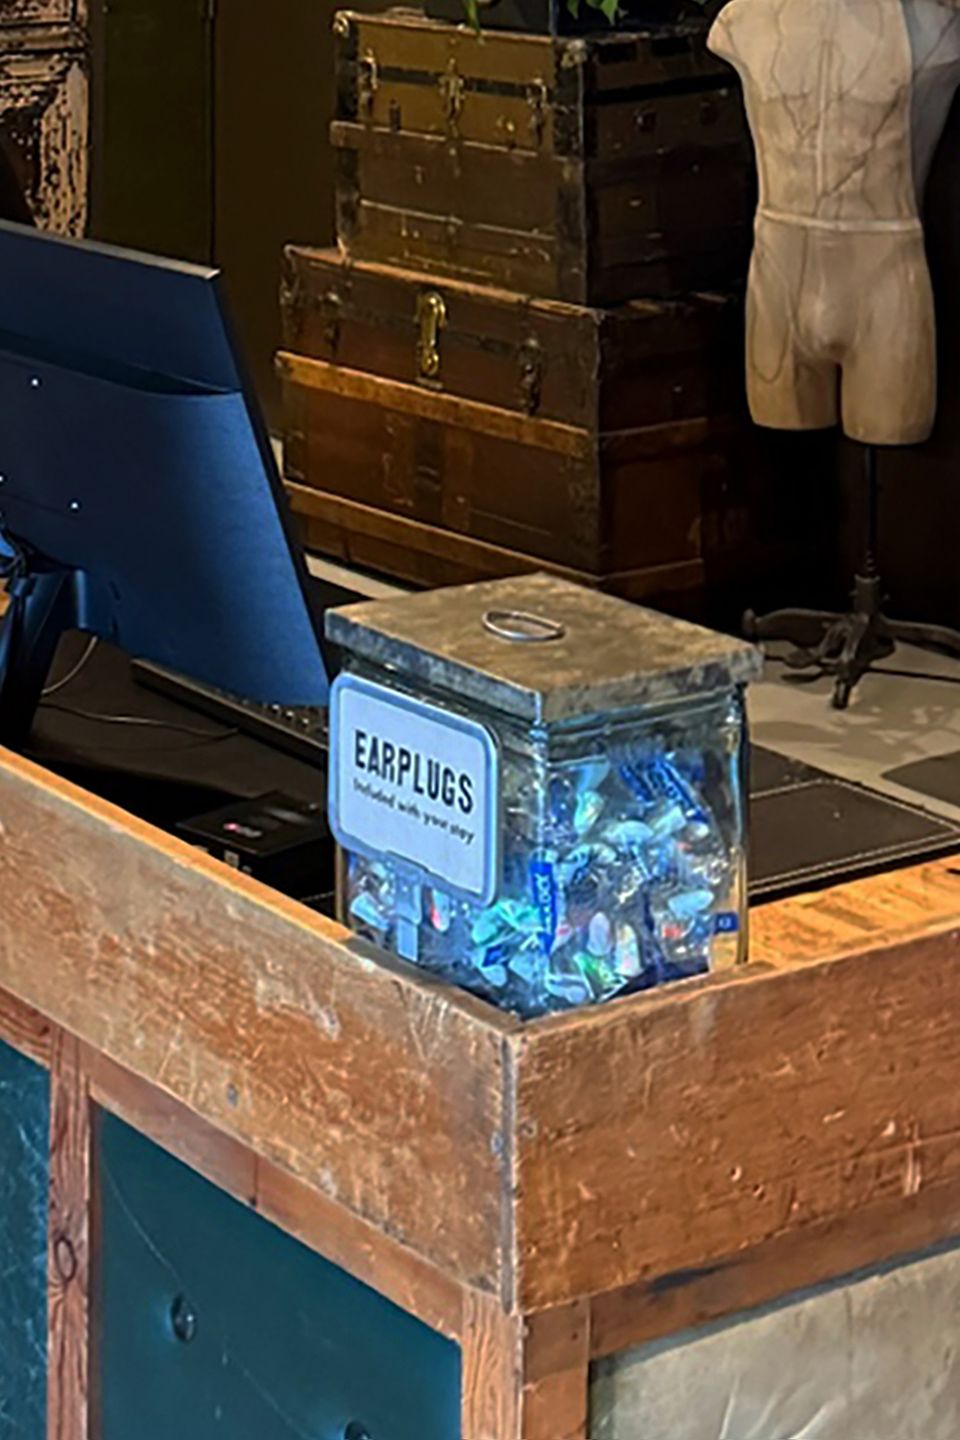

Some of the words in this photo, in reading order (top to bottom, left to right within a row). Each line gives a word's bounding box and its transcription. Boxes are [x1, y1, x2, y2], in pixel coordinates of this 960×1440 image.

[355, 729, 474, 814] EARPLUGS
[353, 777, 396, 809] Included
[398, 801, 420, 818] with
[423, 812, 448, 828] your
[450, 824, 475, 845] stay
